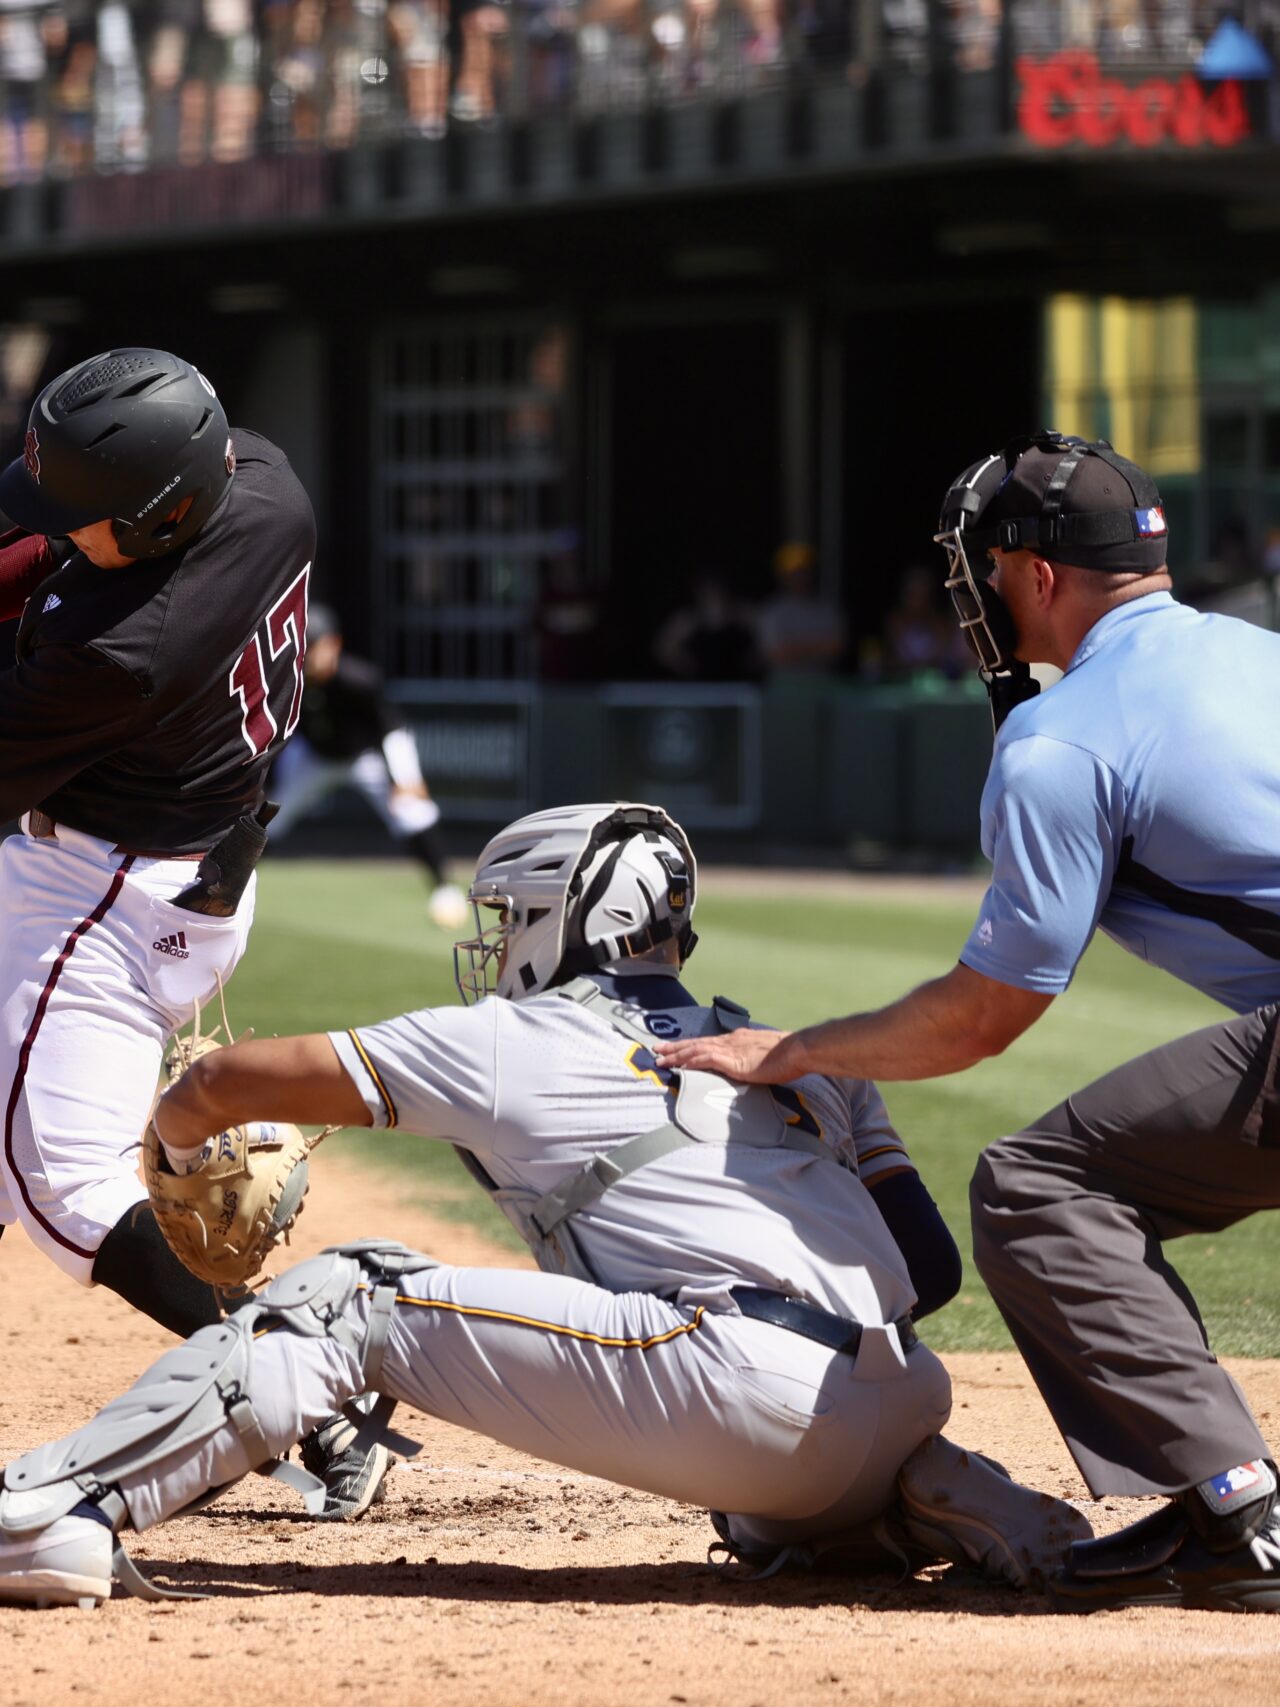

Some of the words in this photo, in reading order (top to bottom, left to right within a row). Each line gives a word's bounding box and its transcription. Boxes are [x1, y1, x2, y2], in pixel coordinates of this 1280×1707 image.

[136, 475, 181, 519] EVOSHIELD
[229, 560, 312, 765] 17
[152, 941, 190, 959] adidas
